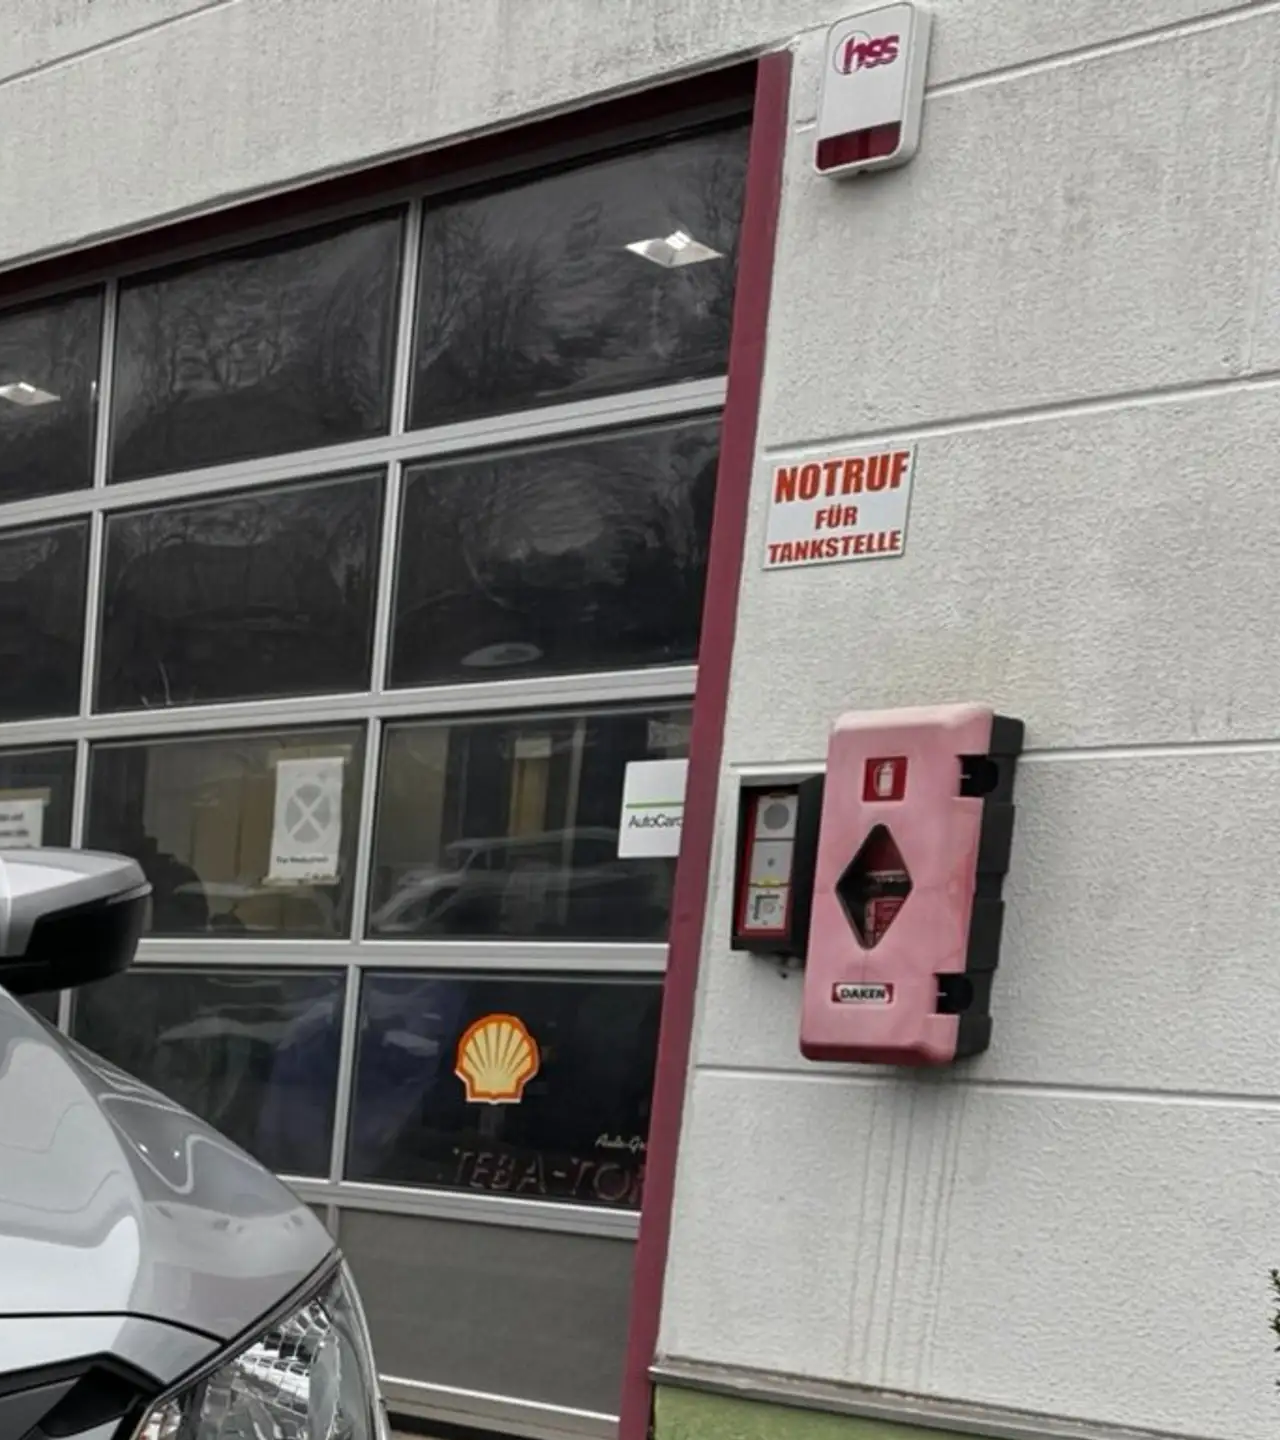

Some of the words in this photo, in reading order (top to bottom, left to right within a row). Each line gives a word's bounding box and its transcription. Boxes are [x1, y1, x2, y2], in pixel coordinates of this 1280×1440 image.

[774, 451, 910, 503] NOTRUF
[814, 505, 858, 530] FÜR
[768, 530, 901, 563] TANKSTELLE
